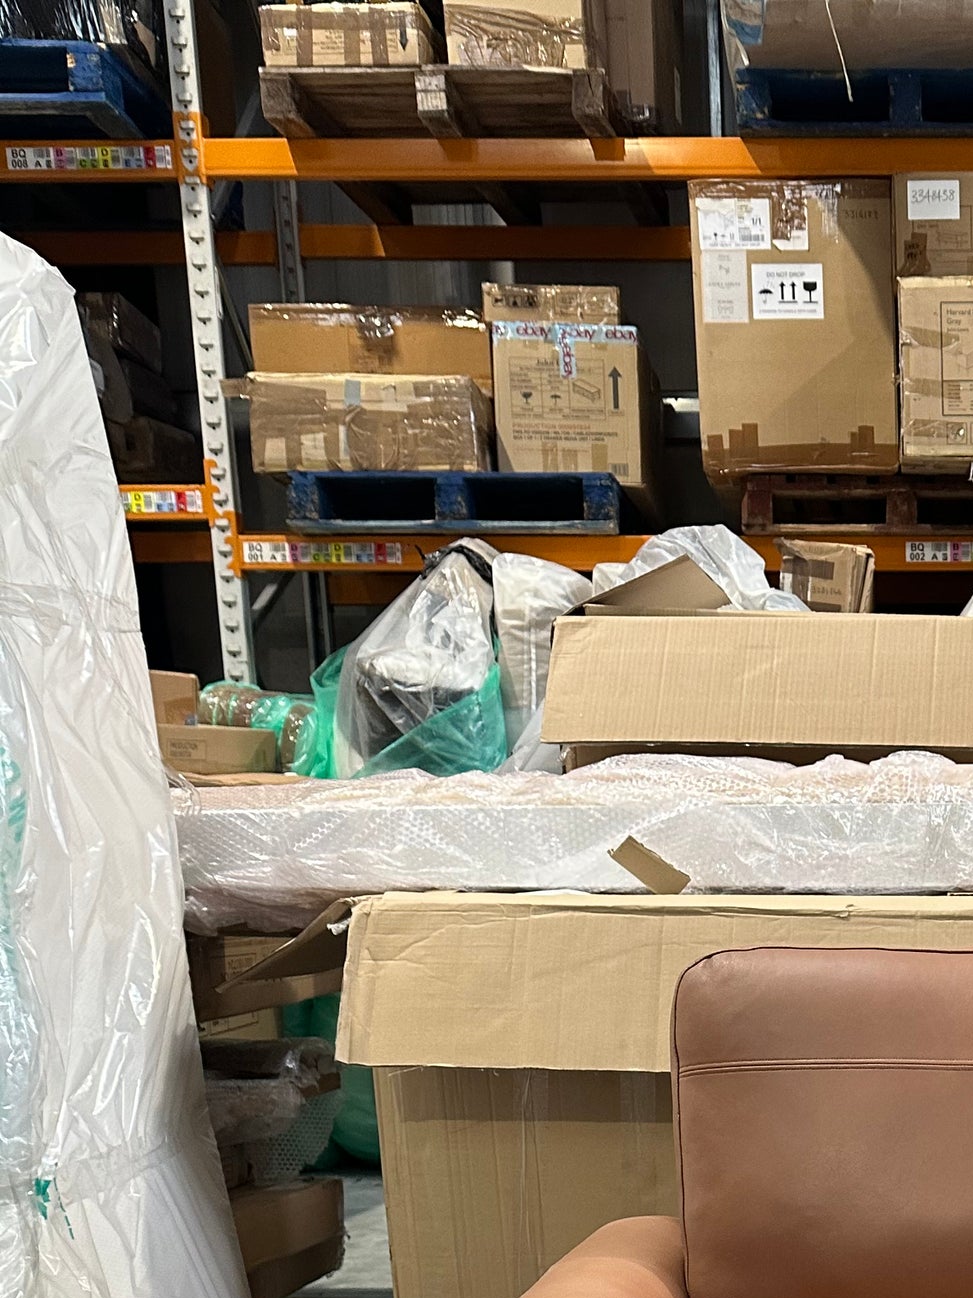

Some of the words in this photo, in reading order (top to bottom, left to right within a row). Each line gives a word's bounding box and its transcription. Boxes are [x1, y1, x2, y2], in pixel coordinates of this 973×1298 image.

[11, 149, 26, 159] BQ
[101, 149, 108, 157] D
[34, 160, 42, 168] A
[946, 318, 961, 326] Gray
[516, 323, 550, 338] ebay
[605, 327, 638, 343] ebay
[134, 493, 141, 501] D
[248, 543, 263, 552] BQ
[334, 543, 342, 551] D
[911, 543, 925, 552] BQ
[270, 553, 277, 561] A
[910, 552, 925, 561] 002
[931, 553, 938, 561] A
